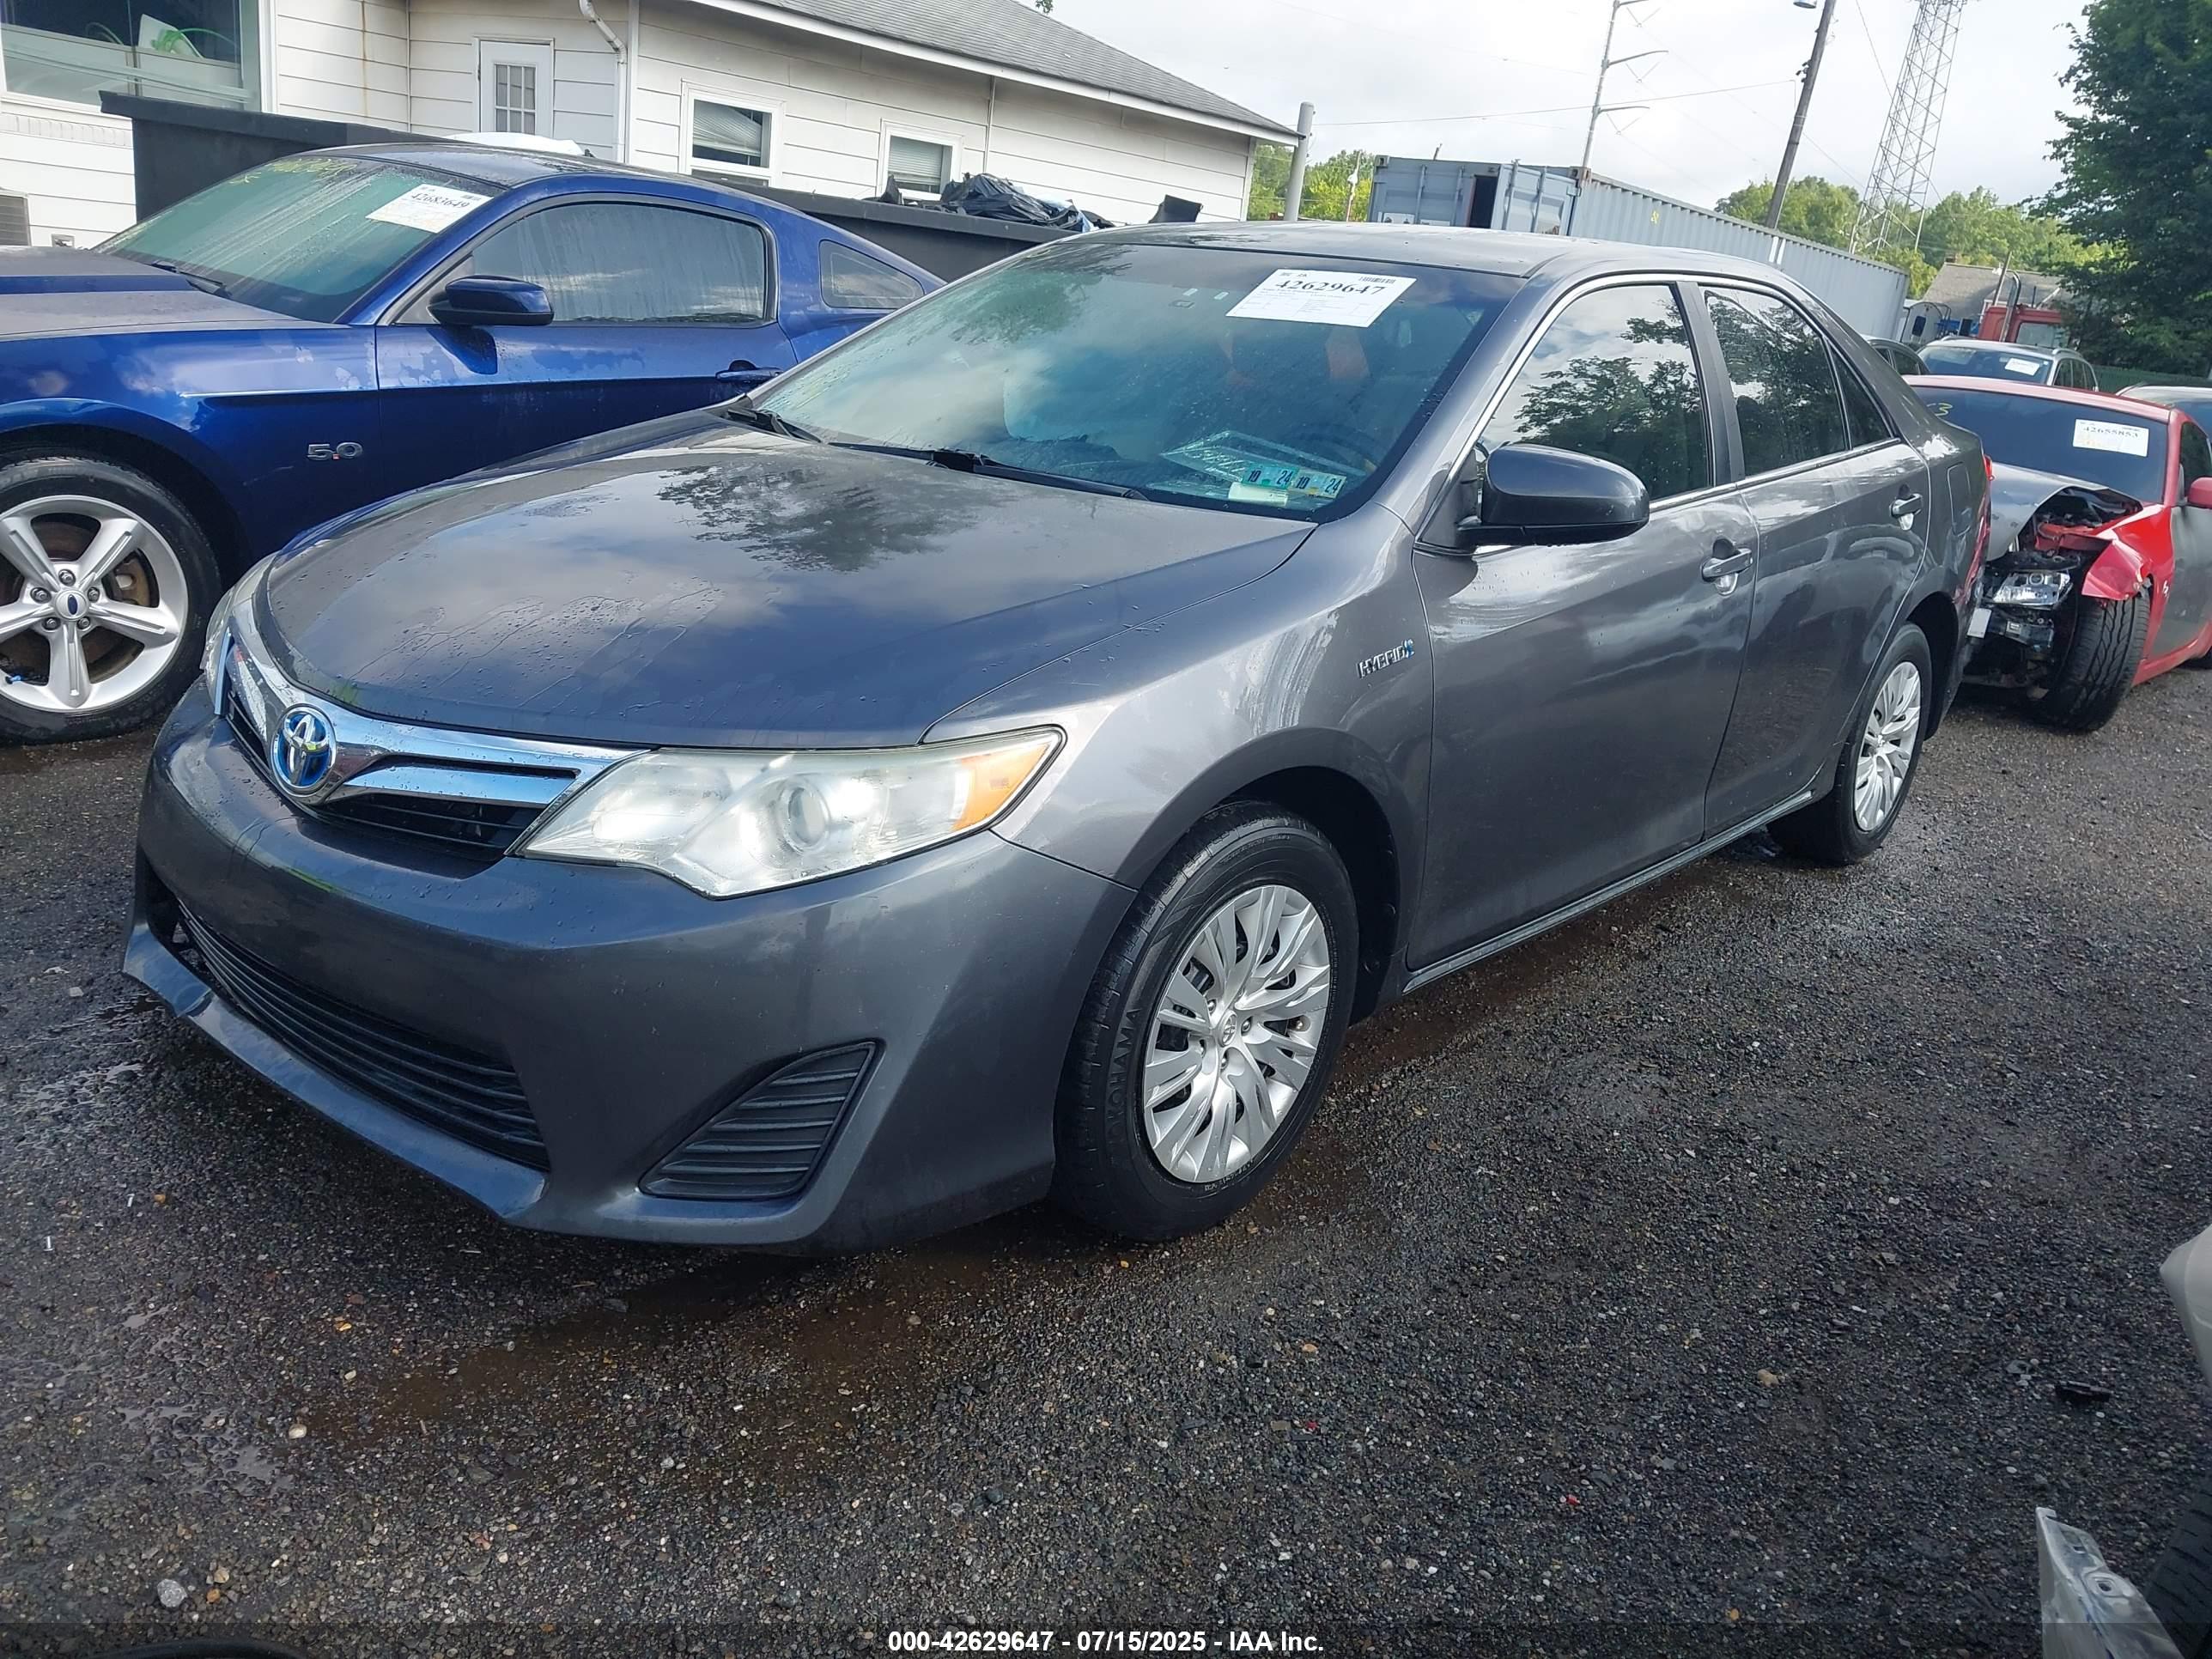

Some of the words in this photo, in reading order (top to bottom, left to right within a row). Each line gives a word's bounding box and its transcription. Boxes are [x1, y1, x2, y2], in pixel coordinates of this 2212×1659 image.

[1275, 280, 1388, 295] 42629647
[307, 441, 363, 461] 5.0
[1248, 470, 1261, 483] 10
[1276, 470, 1293, 486] 24
[1295, 476, 1310, 489] 10
[1324, 477, 1342, 494] 24
[1357, 646, 1407, 678] HYBRID
